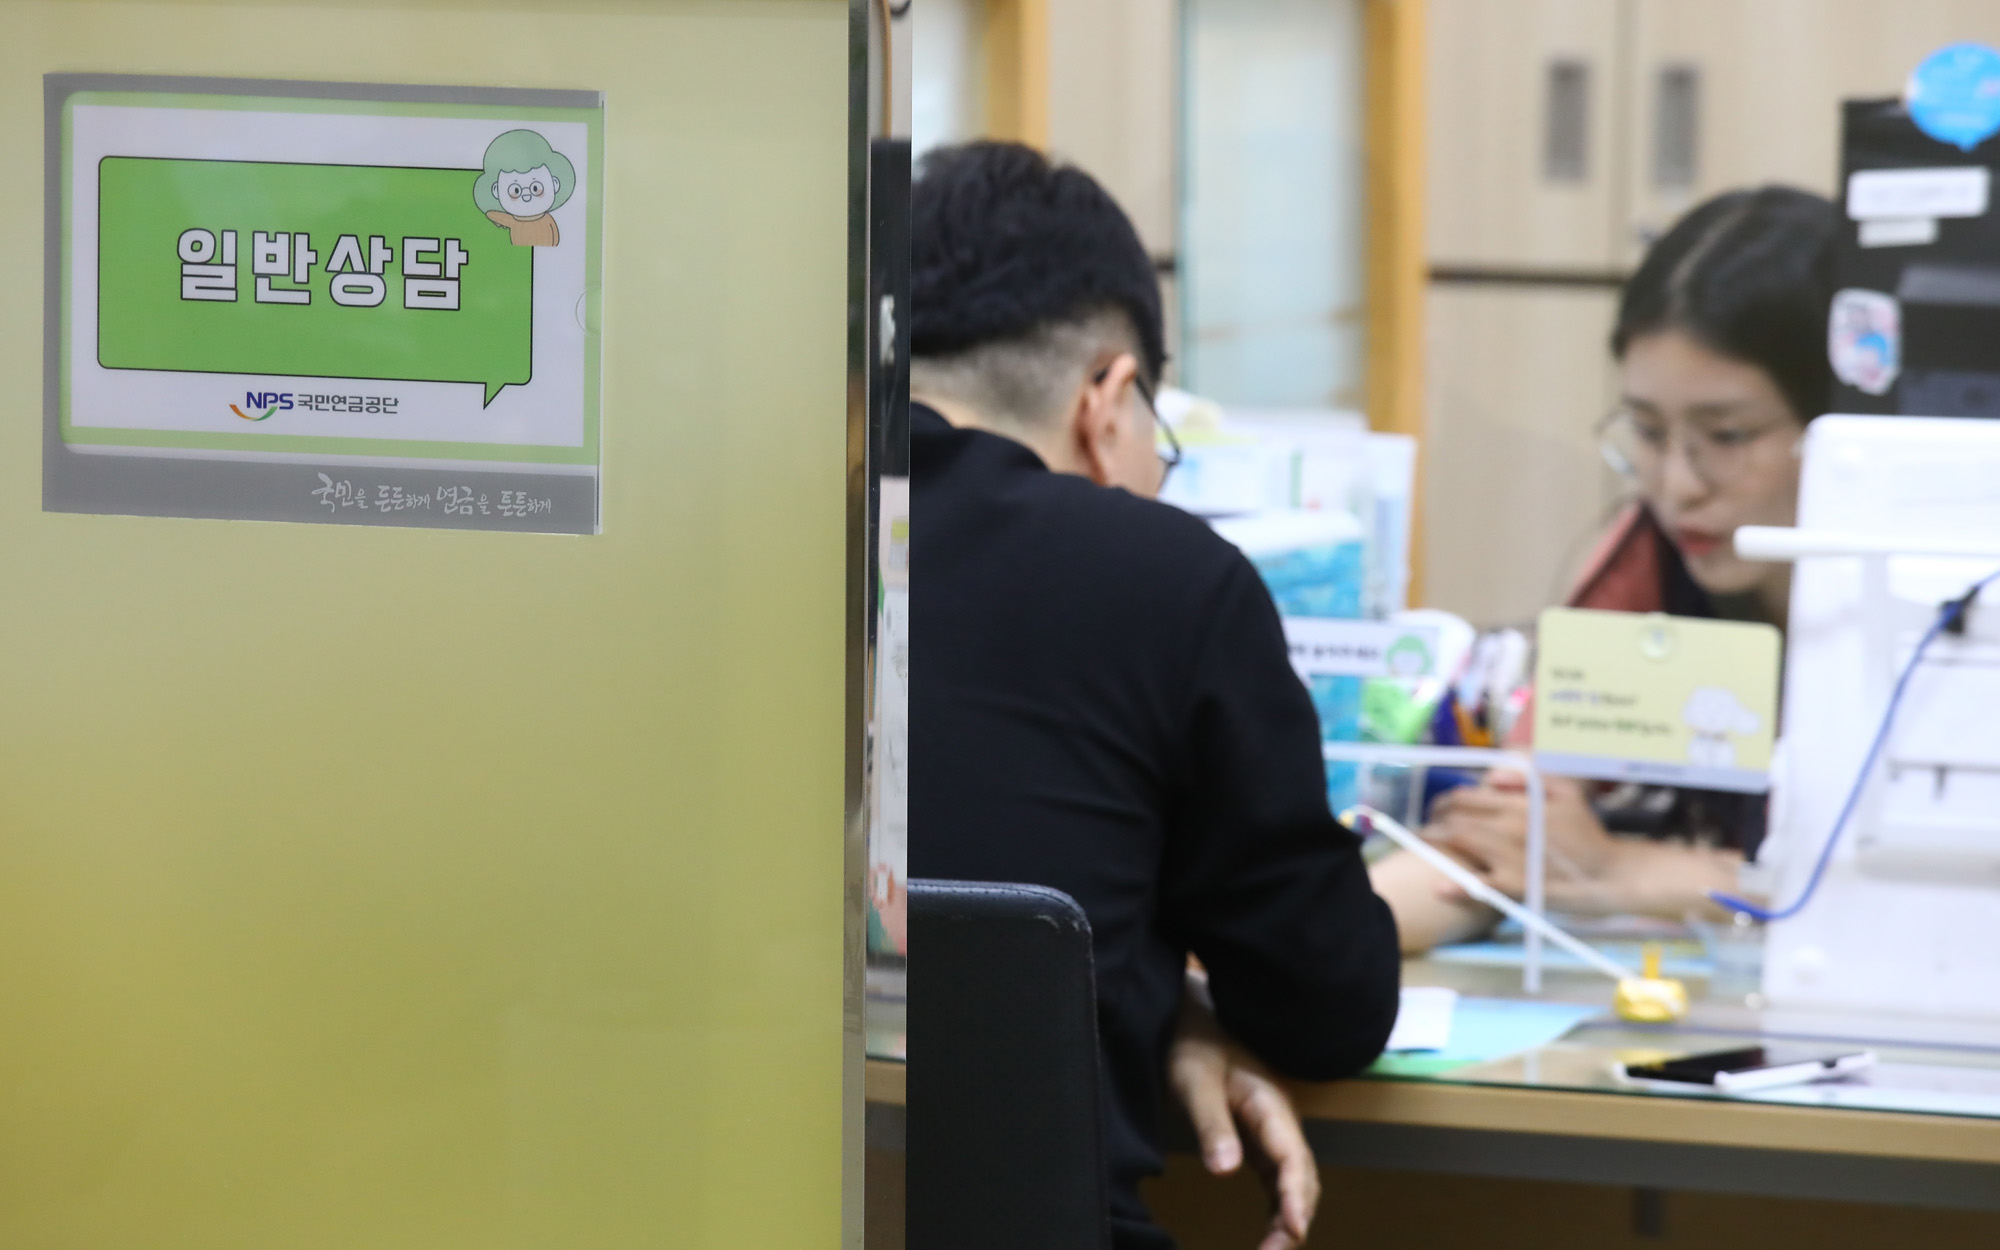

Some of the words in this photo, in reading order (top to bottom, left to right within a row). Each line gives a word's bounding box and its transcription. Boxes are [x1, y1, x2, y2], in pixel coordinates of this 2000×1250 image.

[177, 228, 469, 311] 일반상담
[246, 391, 294, 410] NPS
[298, 393, 399, 414] 국민연금공단
[311, 472, 369, 513] 국민을
[374, 485, 430, 512] 든든하게
[436, 486, 491, 515] 연금을
[497, 490, 552, 517] 튼튼하게
